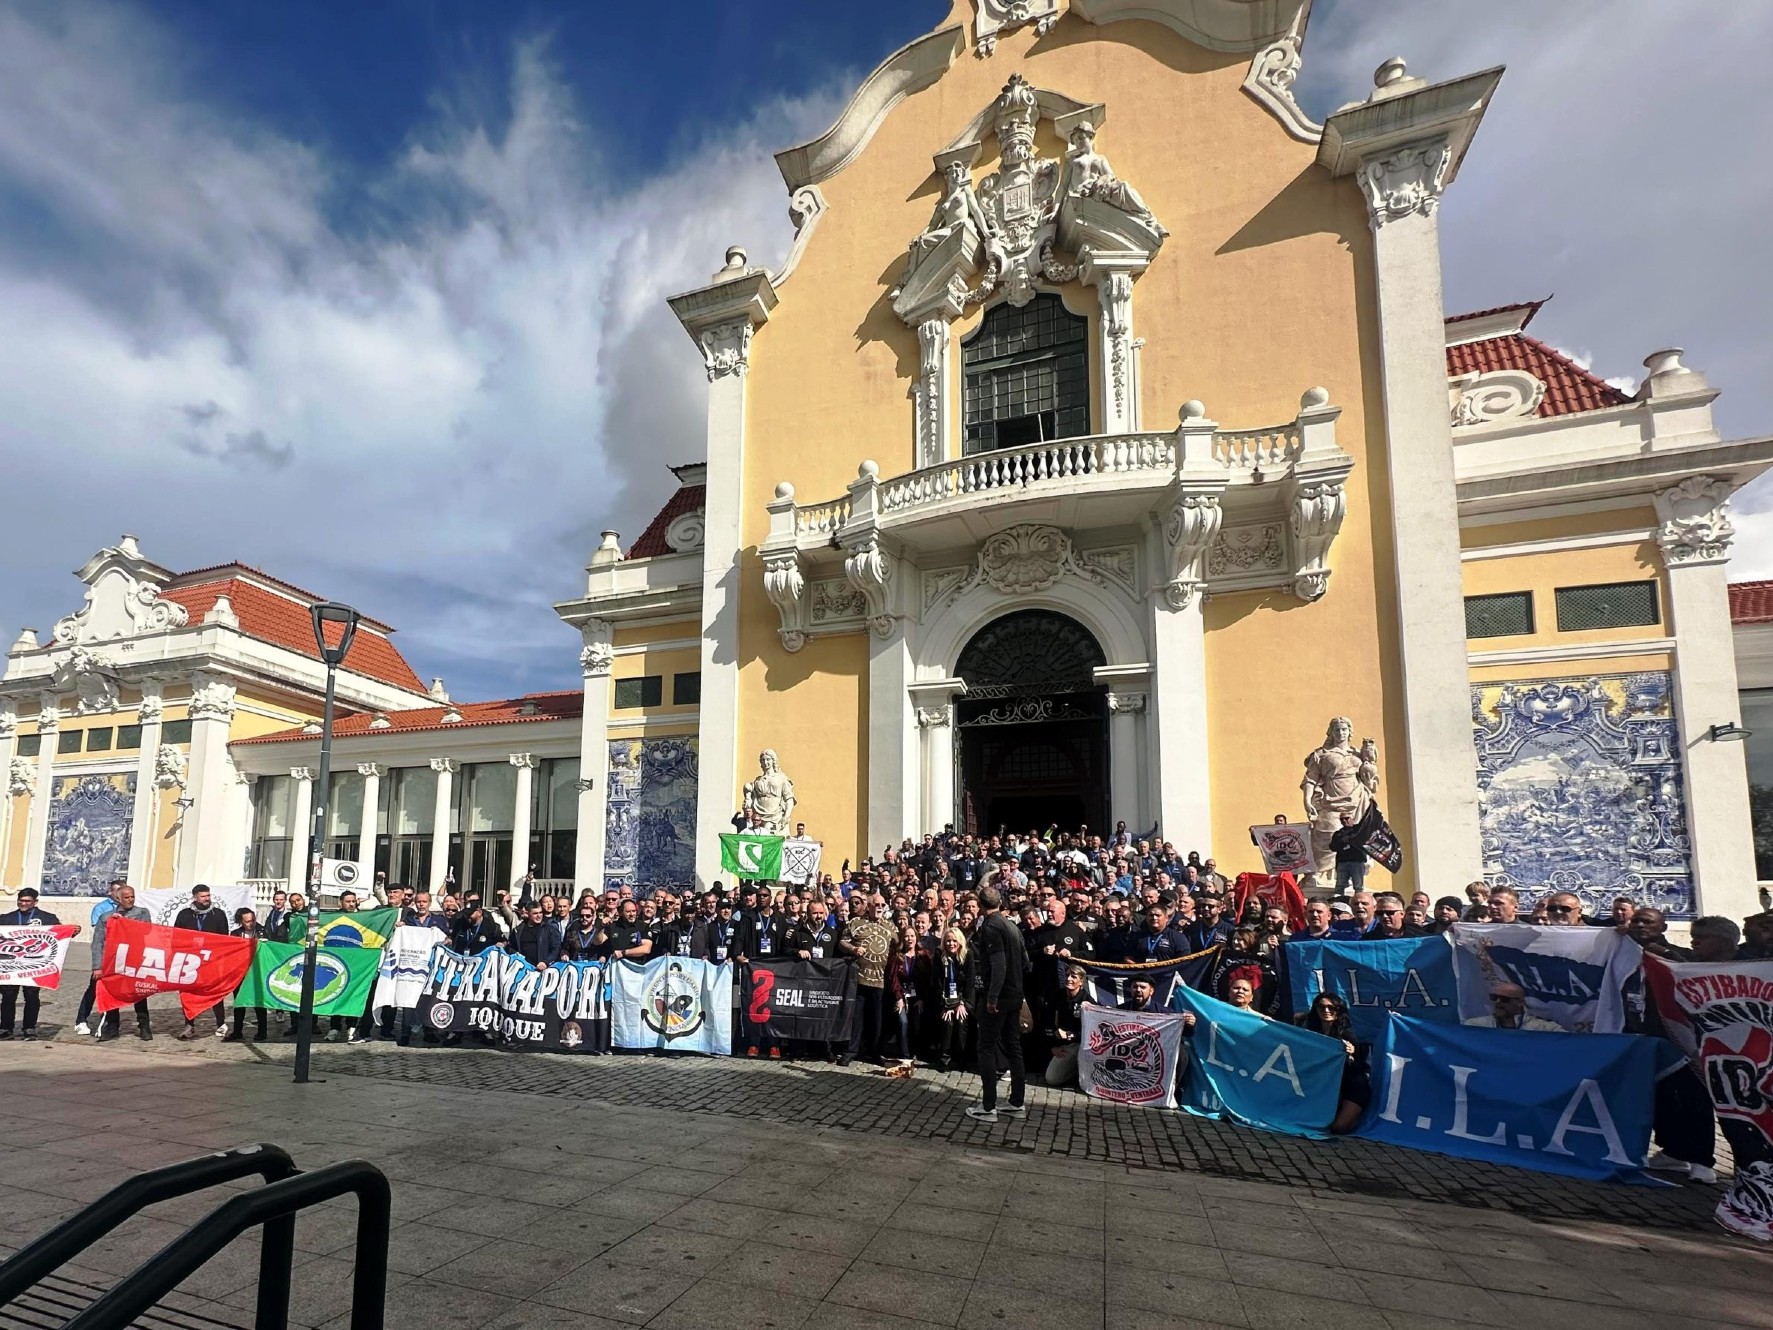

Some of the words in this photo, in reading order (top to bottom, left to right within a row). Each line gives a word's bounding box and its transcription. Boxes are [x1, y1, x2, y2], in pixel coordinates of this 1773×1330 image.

[114, 943, 201, 985] LAB
[775, 988, 805, 1008] SEAL
[1111, 1040, 1146, 1060] IDC
[1379, 1053, 1637, 1167] I.L.A
